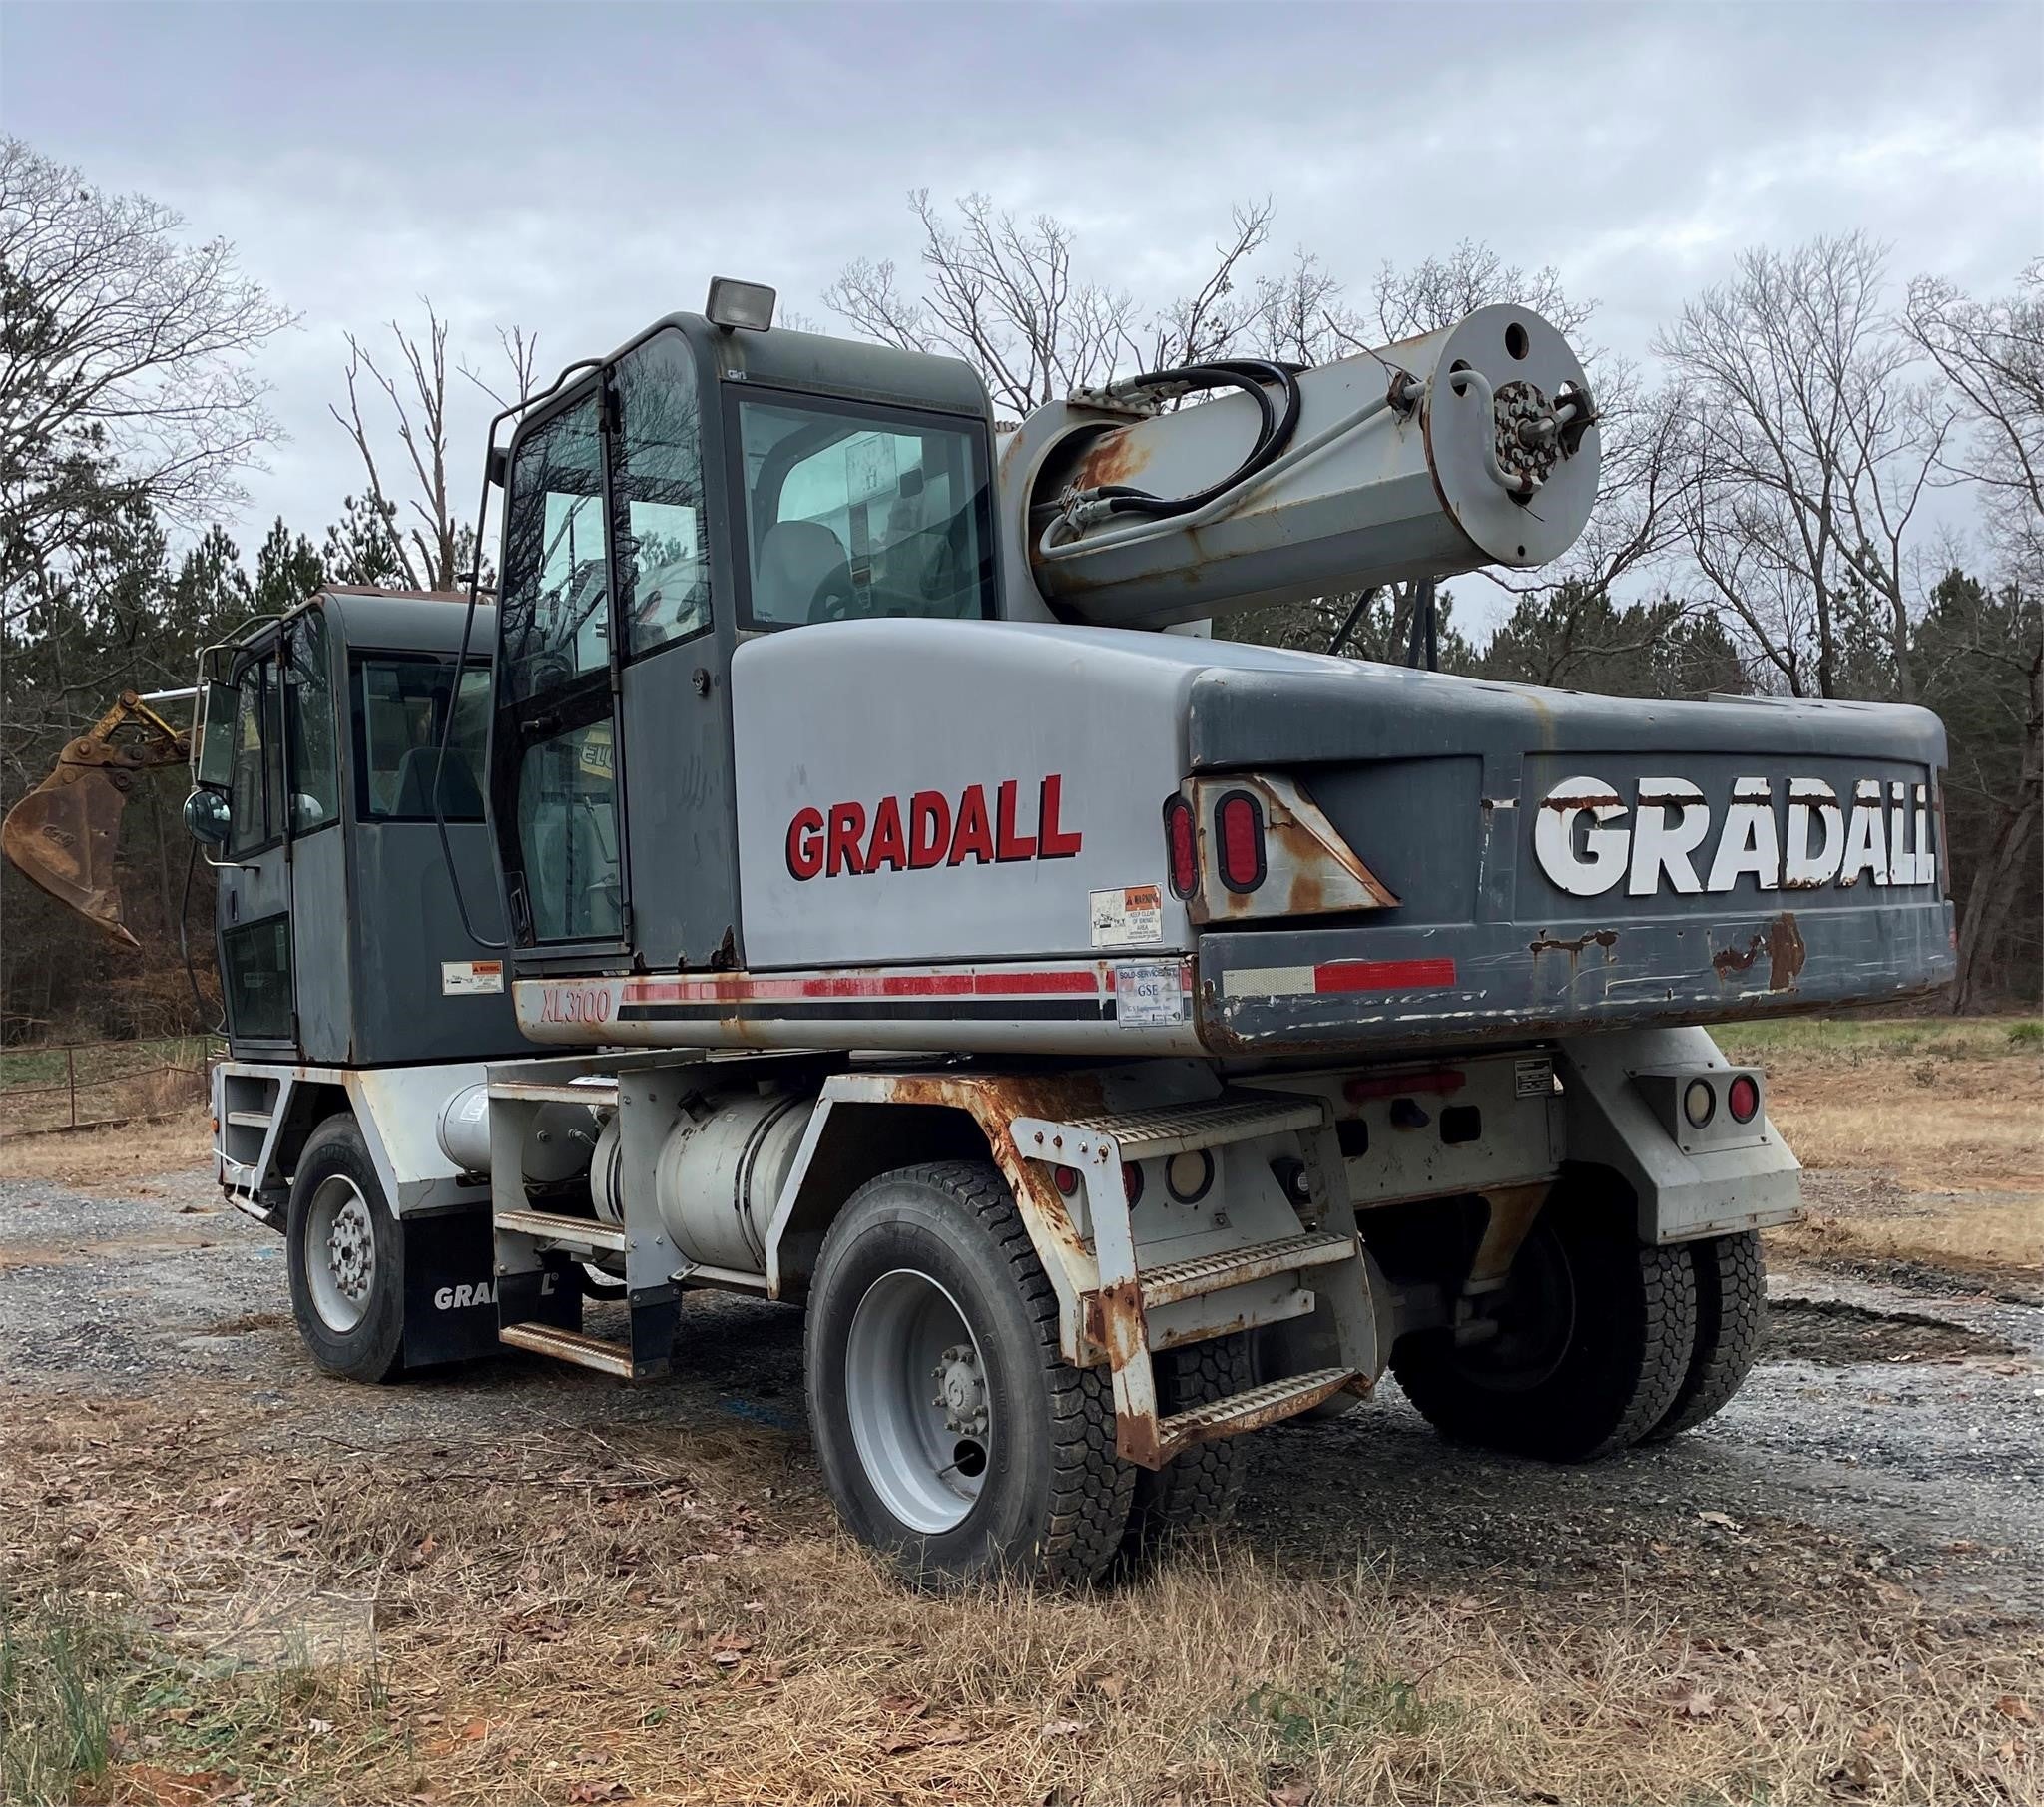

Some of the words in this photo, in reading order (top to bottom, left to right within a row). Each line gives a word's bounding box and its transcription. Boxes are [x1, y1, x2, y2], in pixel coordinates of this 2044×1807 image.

[785, 774, 1082, 881] GRADALL
[1534, 776, 1935, 897] GRADALL
[541, 988, 611, 1023] XL3100
[1138, 984, 1159, 997] GSE
